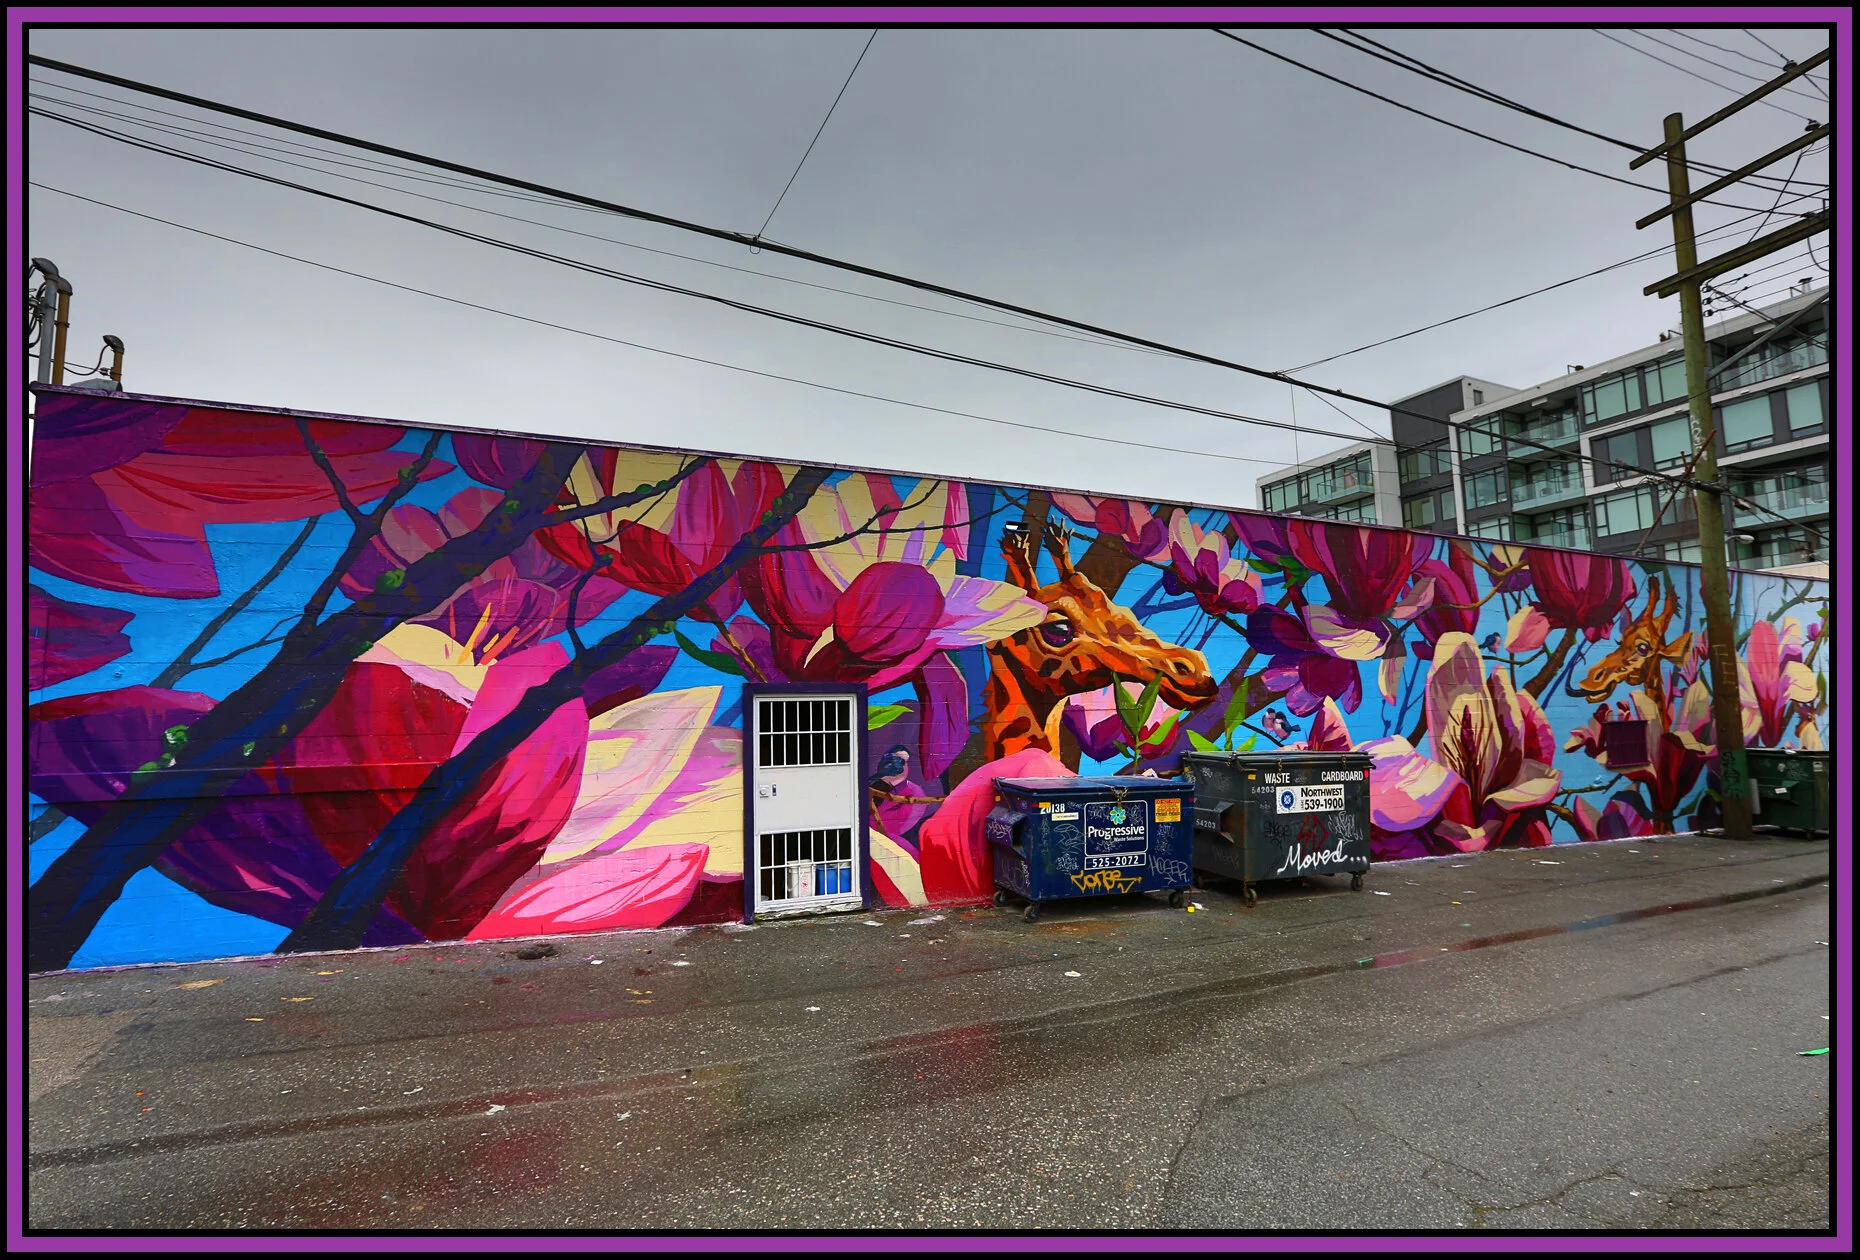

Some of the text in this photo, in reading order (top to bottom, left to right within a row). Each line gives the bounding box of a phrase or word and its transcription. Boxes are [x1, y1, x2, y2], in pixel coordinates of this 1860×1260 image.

[1264, 772, 1291, 784] WASTE
[1321, 770, 1364, 782] CARDBOARD
[1251, 786, 1275, 794] 54203
[1304, 798, 1344, 811] 539-1900
[1195, 819, 1217, 829] 54203
[1087, 823, 1145, 840] Progressive
[1092, 855, 1139, 868] 525-2072
